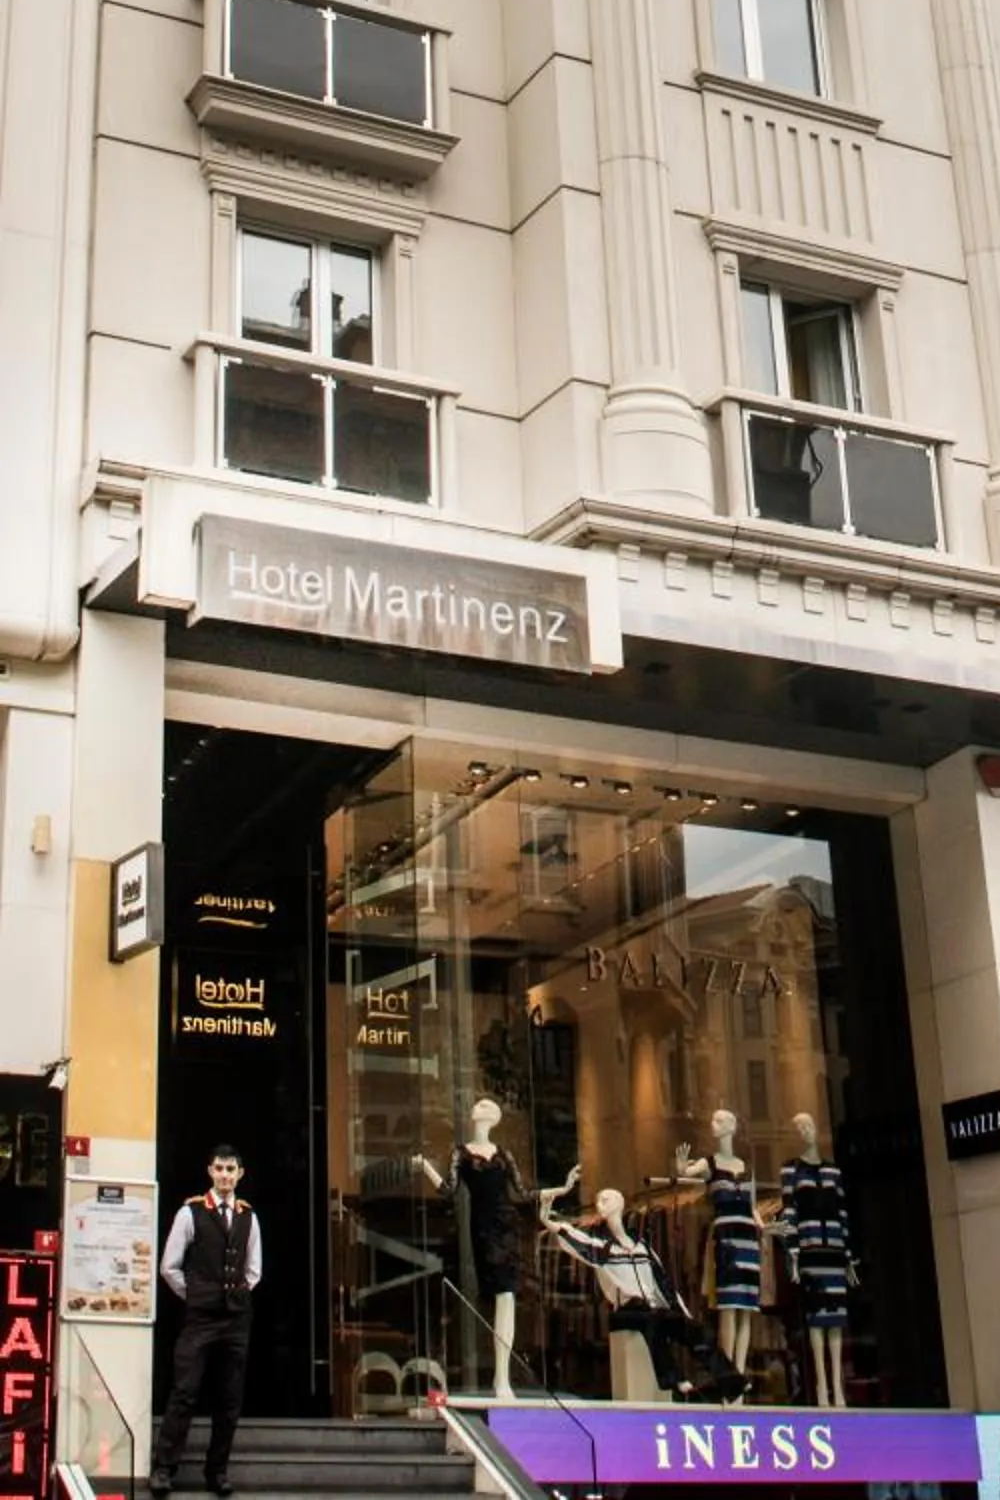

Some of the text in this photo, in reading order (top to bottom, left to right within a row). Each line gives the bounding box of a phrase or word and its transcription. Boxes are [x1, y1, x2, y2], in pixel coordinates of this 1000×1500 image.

[227, 550, 569, 643] Hotel Martinenz
[0, 1264, 43, 1500] LAFi
[655, 1423, 836, 1471] iNESS
